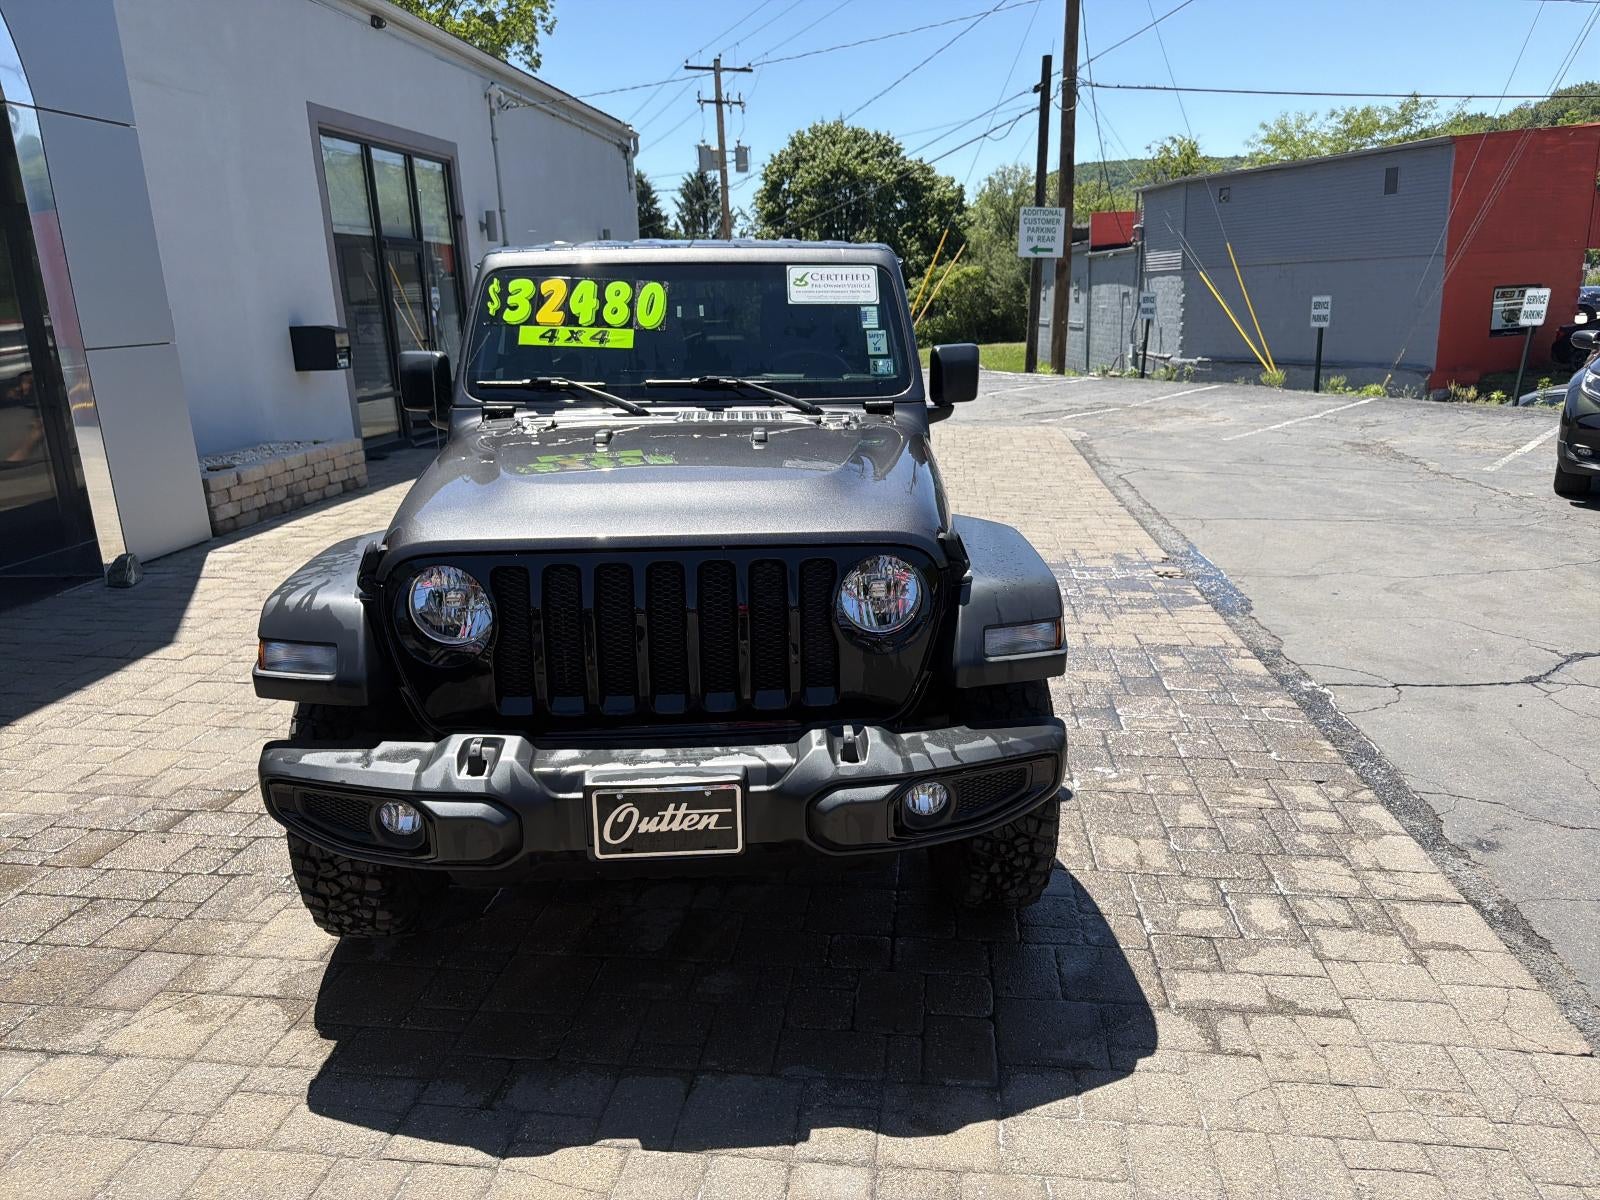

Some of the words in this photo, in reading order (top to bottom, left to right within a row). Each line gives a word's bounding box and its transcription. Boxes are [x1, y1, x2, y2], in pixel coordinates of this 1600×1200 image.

[1022, 209, 1062, 217] ADDITIONAL
[810, 272, 870, 281] CERTIFIED
[487, 277, 667, 330] $32480
[1526, 294, 1547, 304] SERVICE
[1313, 301, 1329, 310] SERVICE
[1523, 309, 1544, 319] PARKING
[603, 802, 732, 845] Outten
